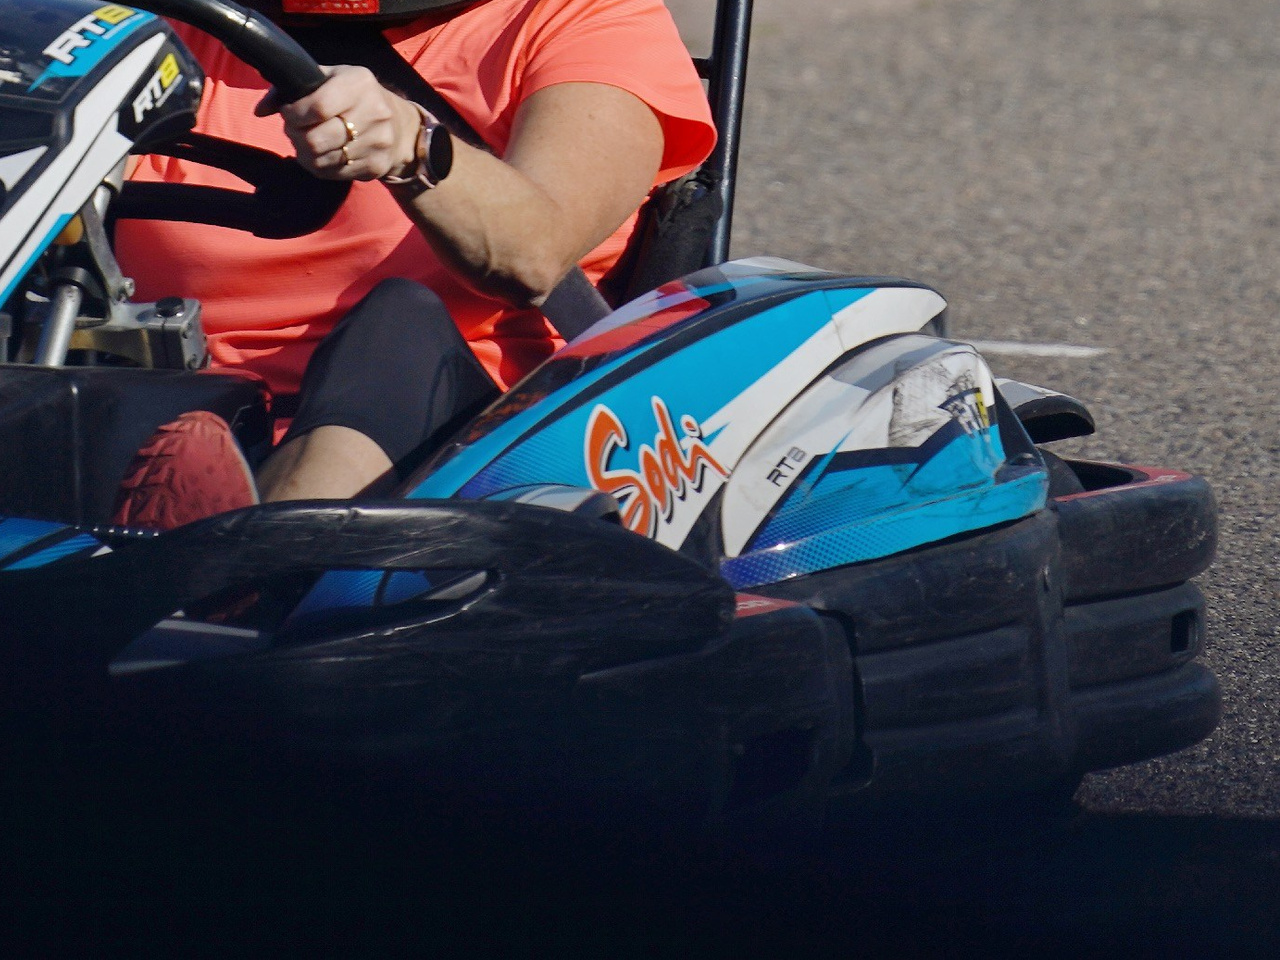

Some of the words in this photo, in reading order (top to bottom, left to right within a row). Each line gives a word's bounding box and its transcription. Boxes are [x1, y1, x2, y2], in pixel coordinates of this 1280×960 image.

[42, 4, 136, 65] RT8
[132, 53, 180, 123] RT8
[584, 395, 732, 541] Sodi
[766, 446, 808, 487] RT8
